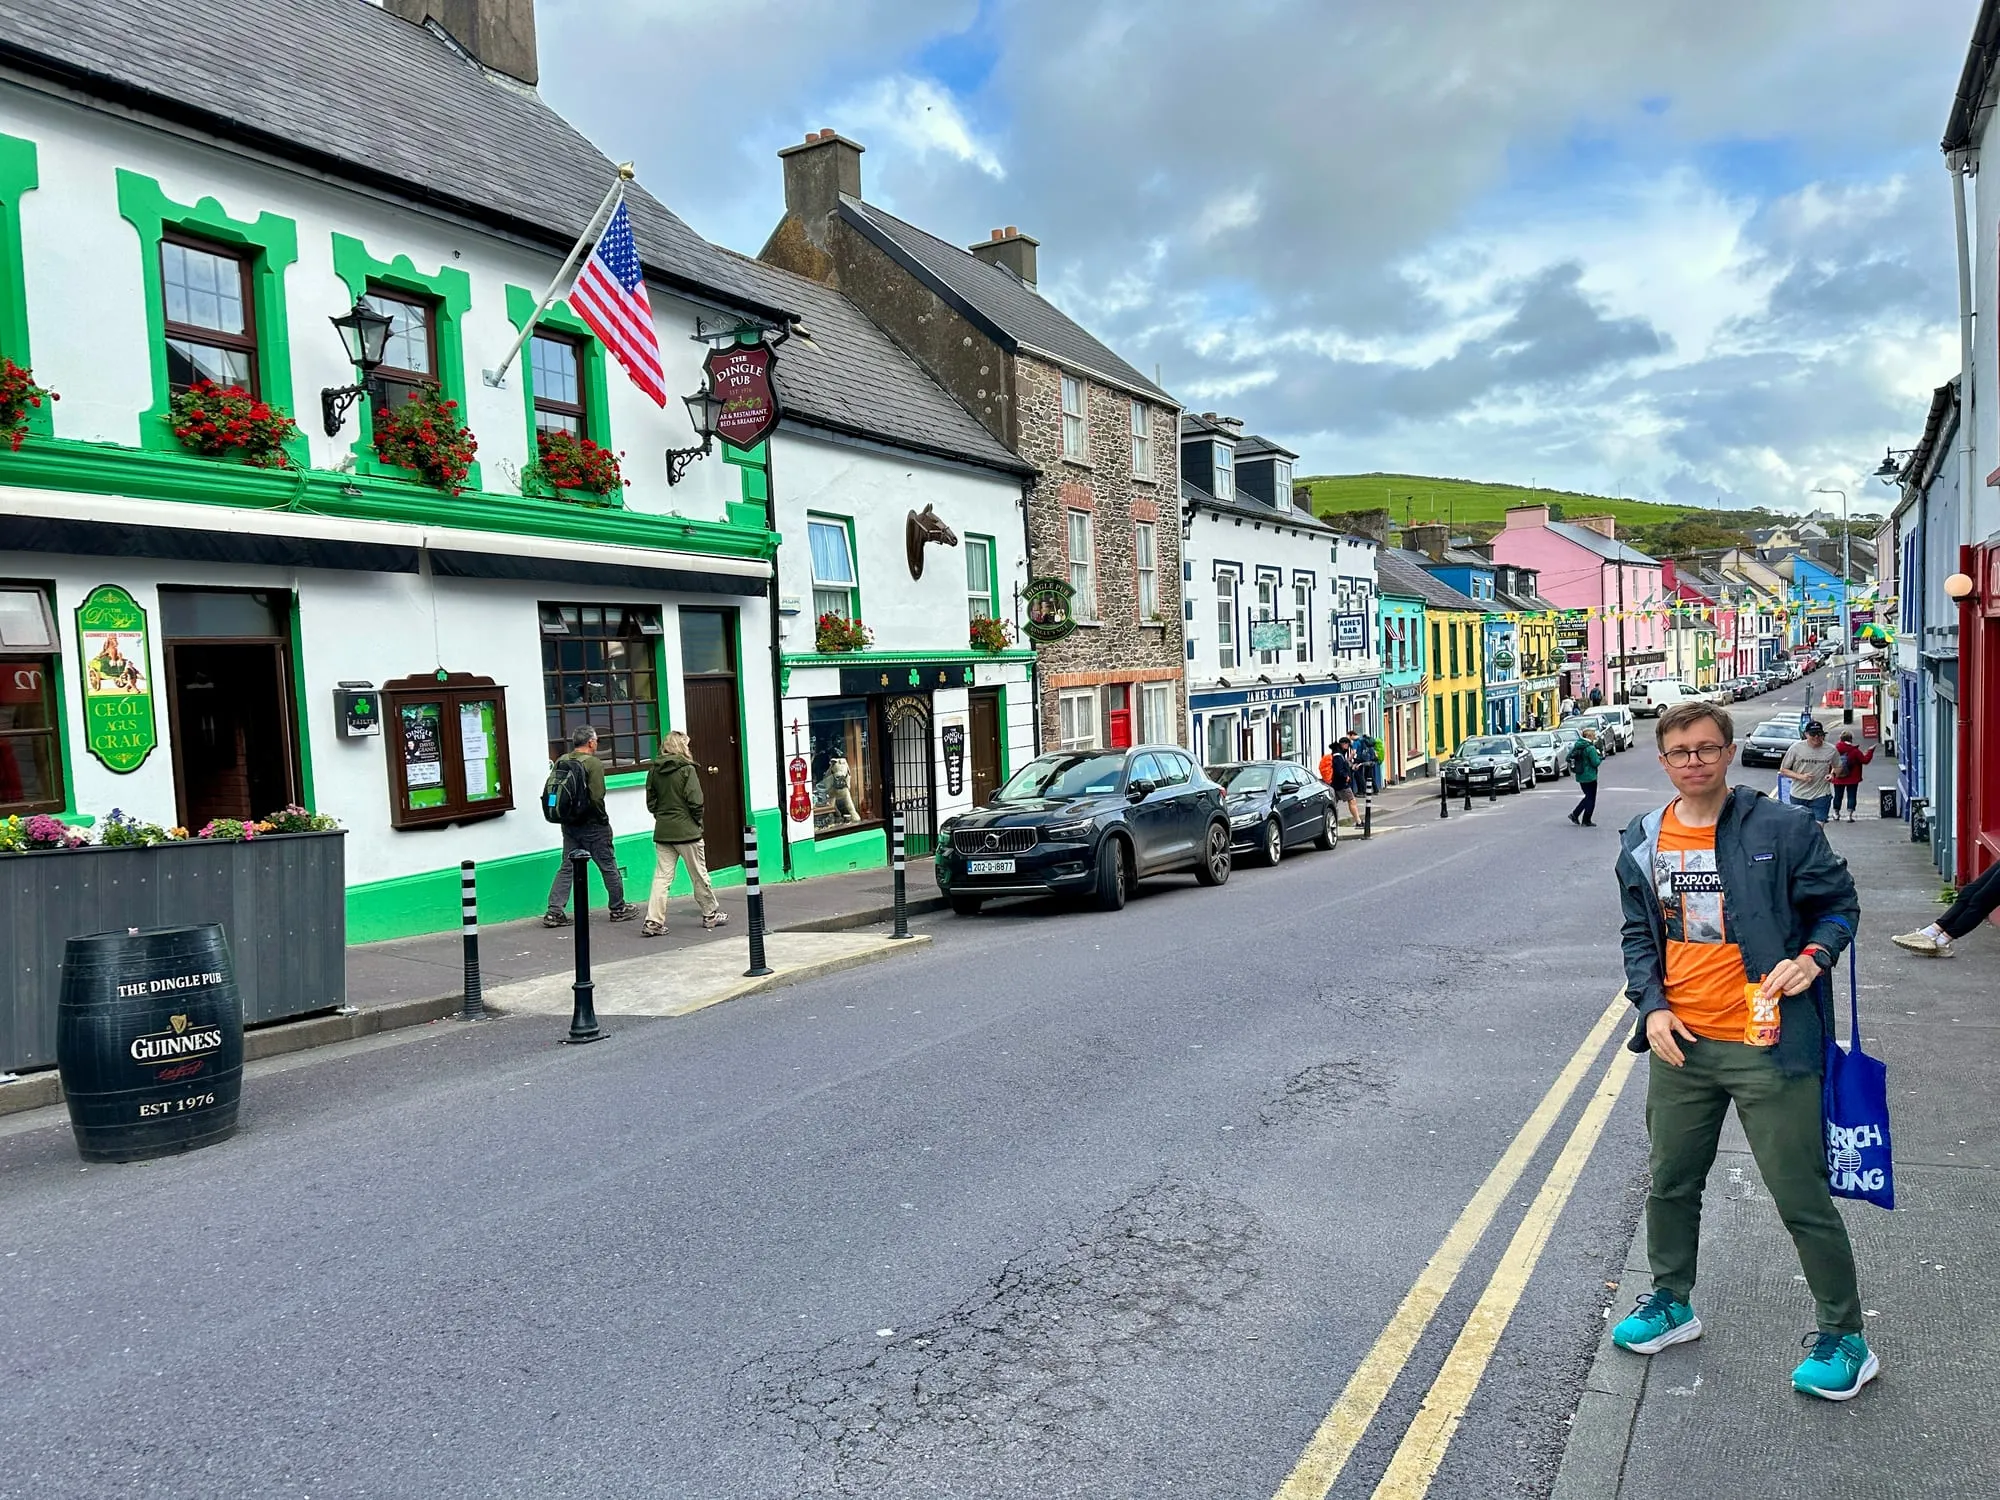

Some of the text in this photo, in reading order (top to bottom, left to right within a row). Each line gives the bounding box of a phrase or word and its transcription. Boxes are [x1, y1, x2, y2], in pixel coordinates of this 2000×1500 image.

[730, 355, 747, 364] THE
[716, 363, 763, 382] DINGLE
[730, 375, 750, 387] PUB
[737, 416, 766, 425] BREAKFAST
[1026, 582, 1070, 598] DINGLE PUB
[1343, 626, 1357, 634] BAR
[1246, 689, 1269, 703] JAMES
[95, 697, 144, 717] CEÓL
[105, 719, 137, 732] AGUS
[95, 732, 148, 750] CRAIC
[405, 728, 433, 739] DINGLE
[117, 972, 222, 998] THE DINGLE PUB
[130, 1029, 222, 1060] GUINNESS
[139, 1092, 215, 1117] EST 1976
